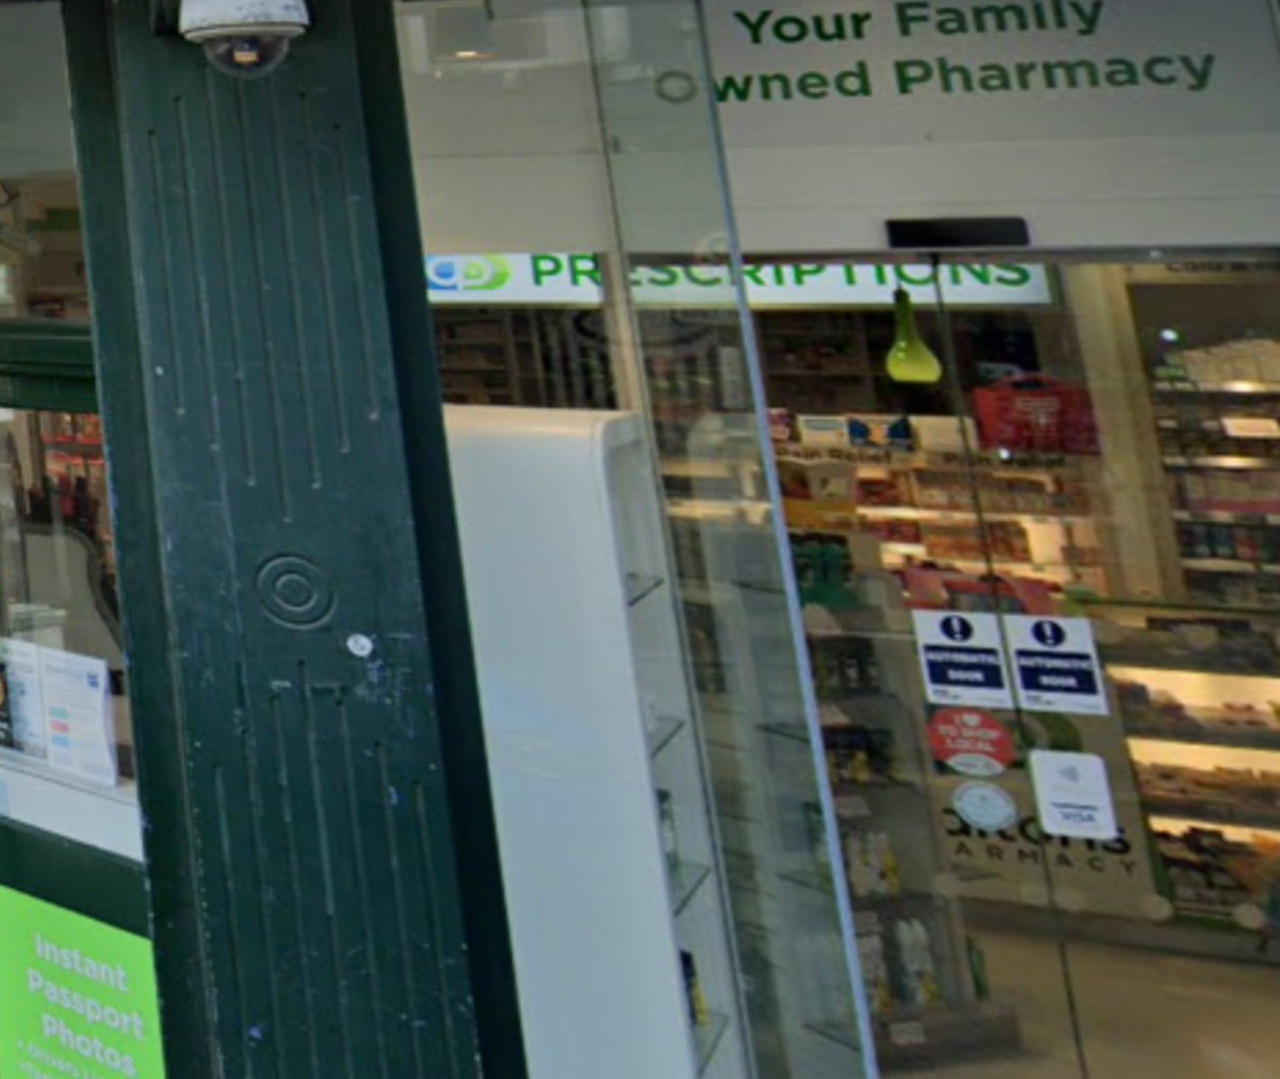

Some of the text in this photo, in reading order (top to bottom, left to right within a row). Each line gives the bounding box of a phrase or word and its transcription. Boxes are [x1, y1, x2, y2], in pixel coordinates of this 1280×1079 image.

[734, 8, 872, 45] Your
[654, 51, 1216, 104] Owned Pharmacy
[531, 254, 1032, 287] PRSCRIPTIONS
[953, 840, 1138, 873] ARMACY
[33, 930, 129, 994] Instant
[27, 967, 146, 1043] Passport
[42, 1011, 137, 1078] Photos
